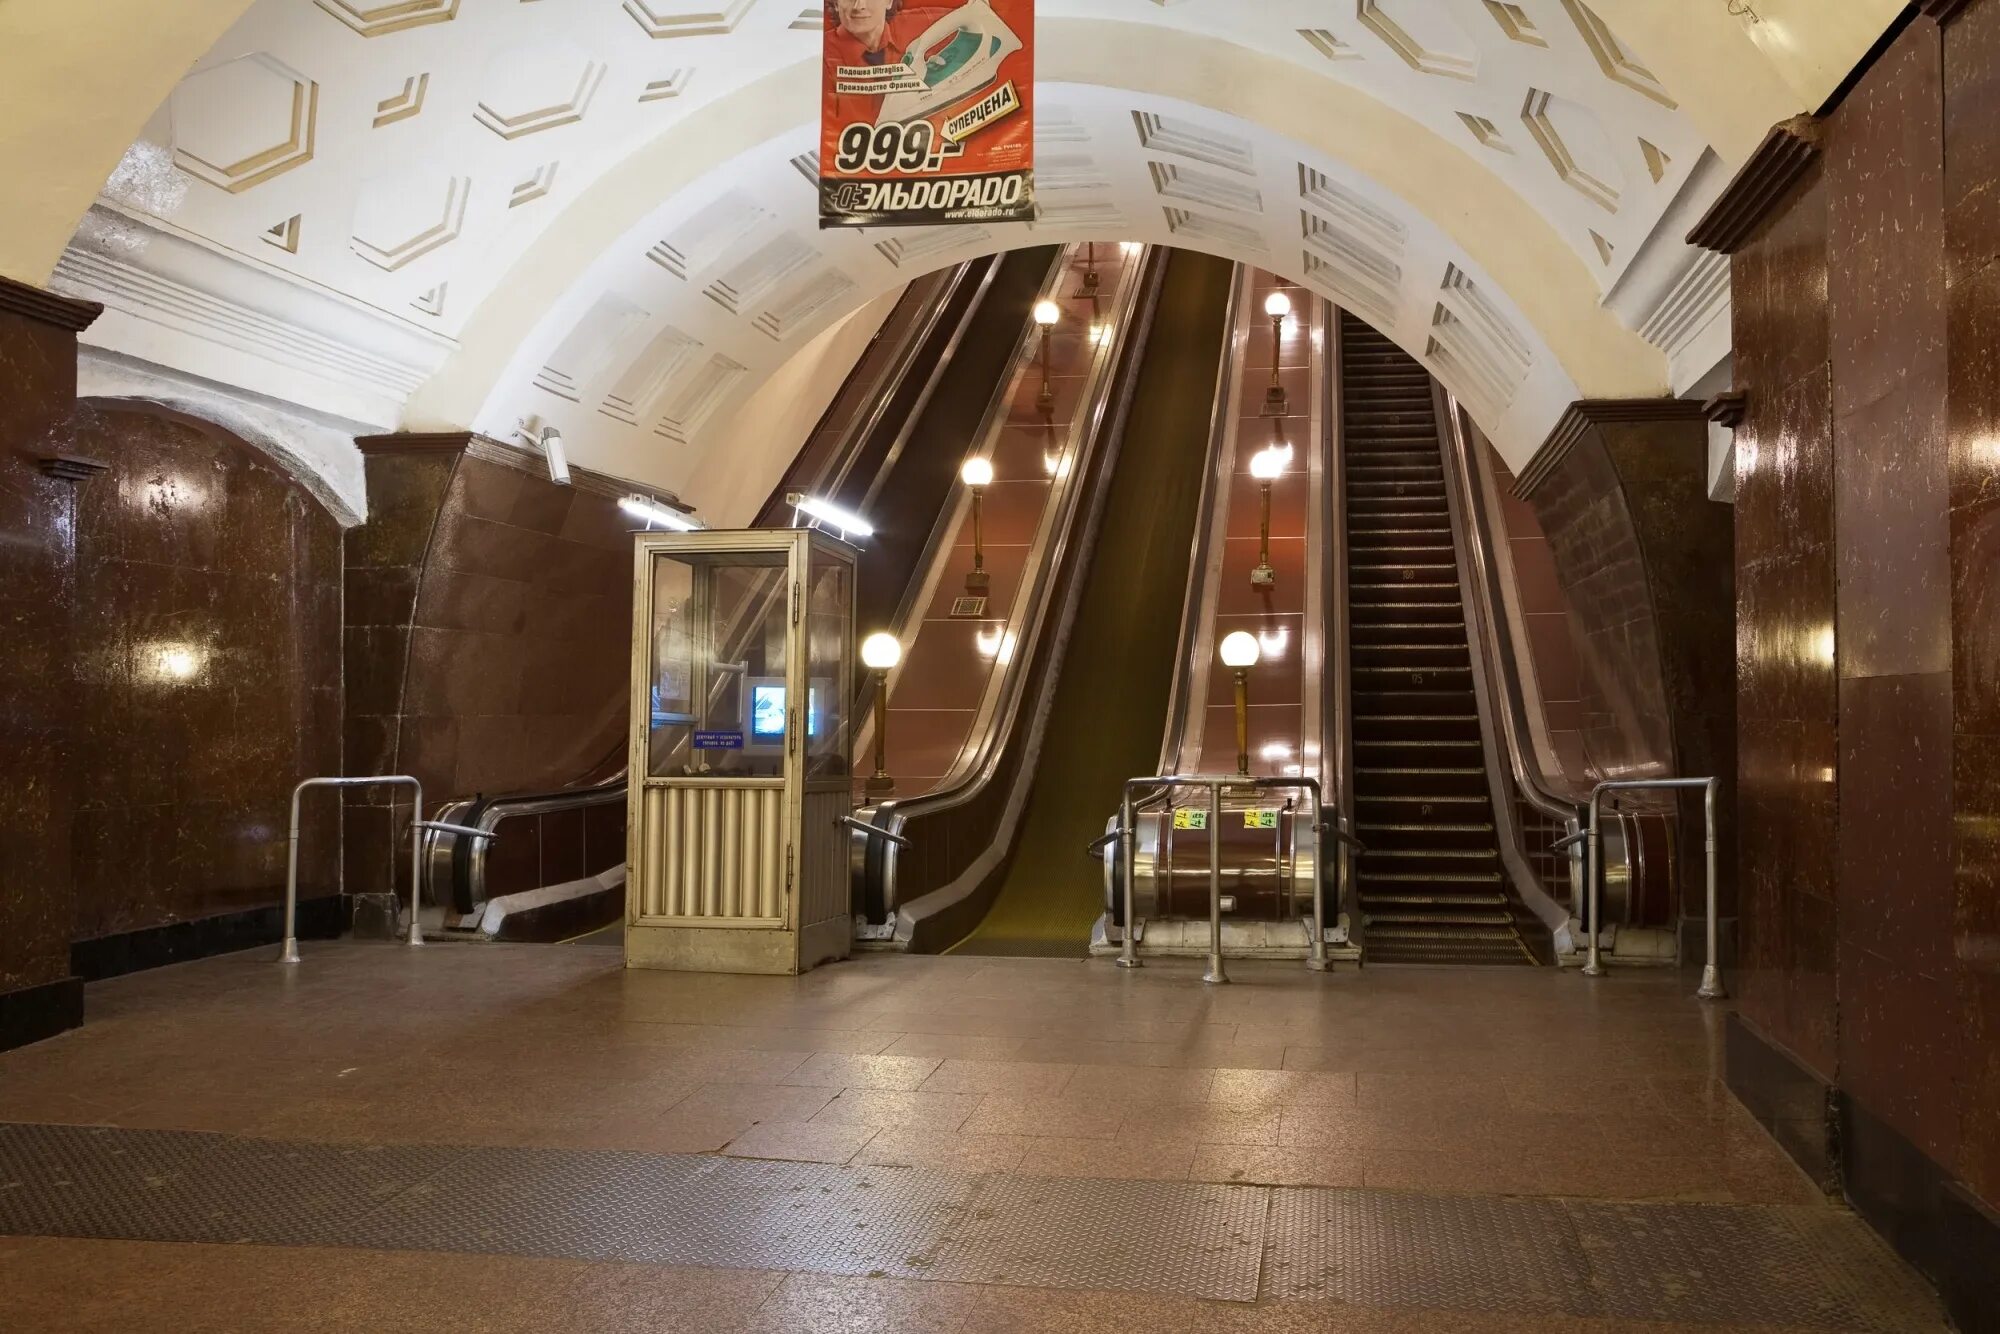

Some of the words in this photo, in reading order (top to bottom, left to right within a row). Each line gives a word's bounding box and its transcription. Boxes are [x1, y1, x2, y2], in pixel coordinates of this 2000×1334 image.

[838, 67, 871, 76] Подошва
[872, 65, 904, 75] Ultragliss
[838, 83, 888, 92] Производство
[948, 87, 1012, 135] СУПЕРЦЕНА
[944, 208, 1014, 219] www.eldorado.ru
